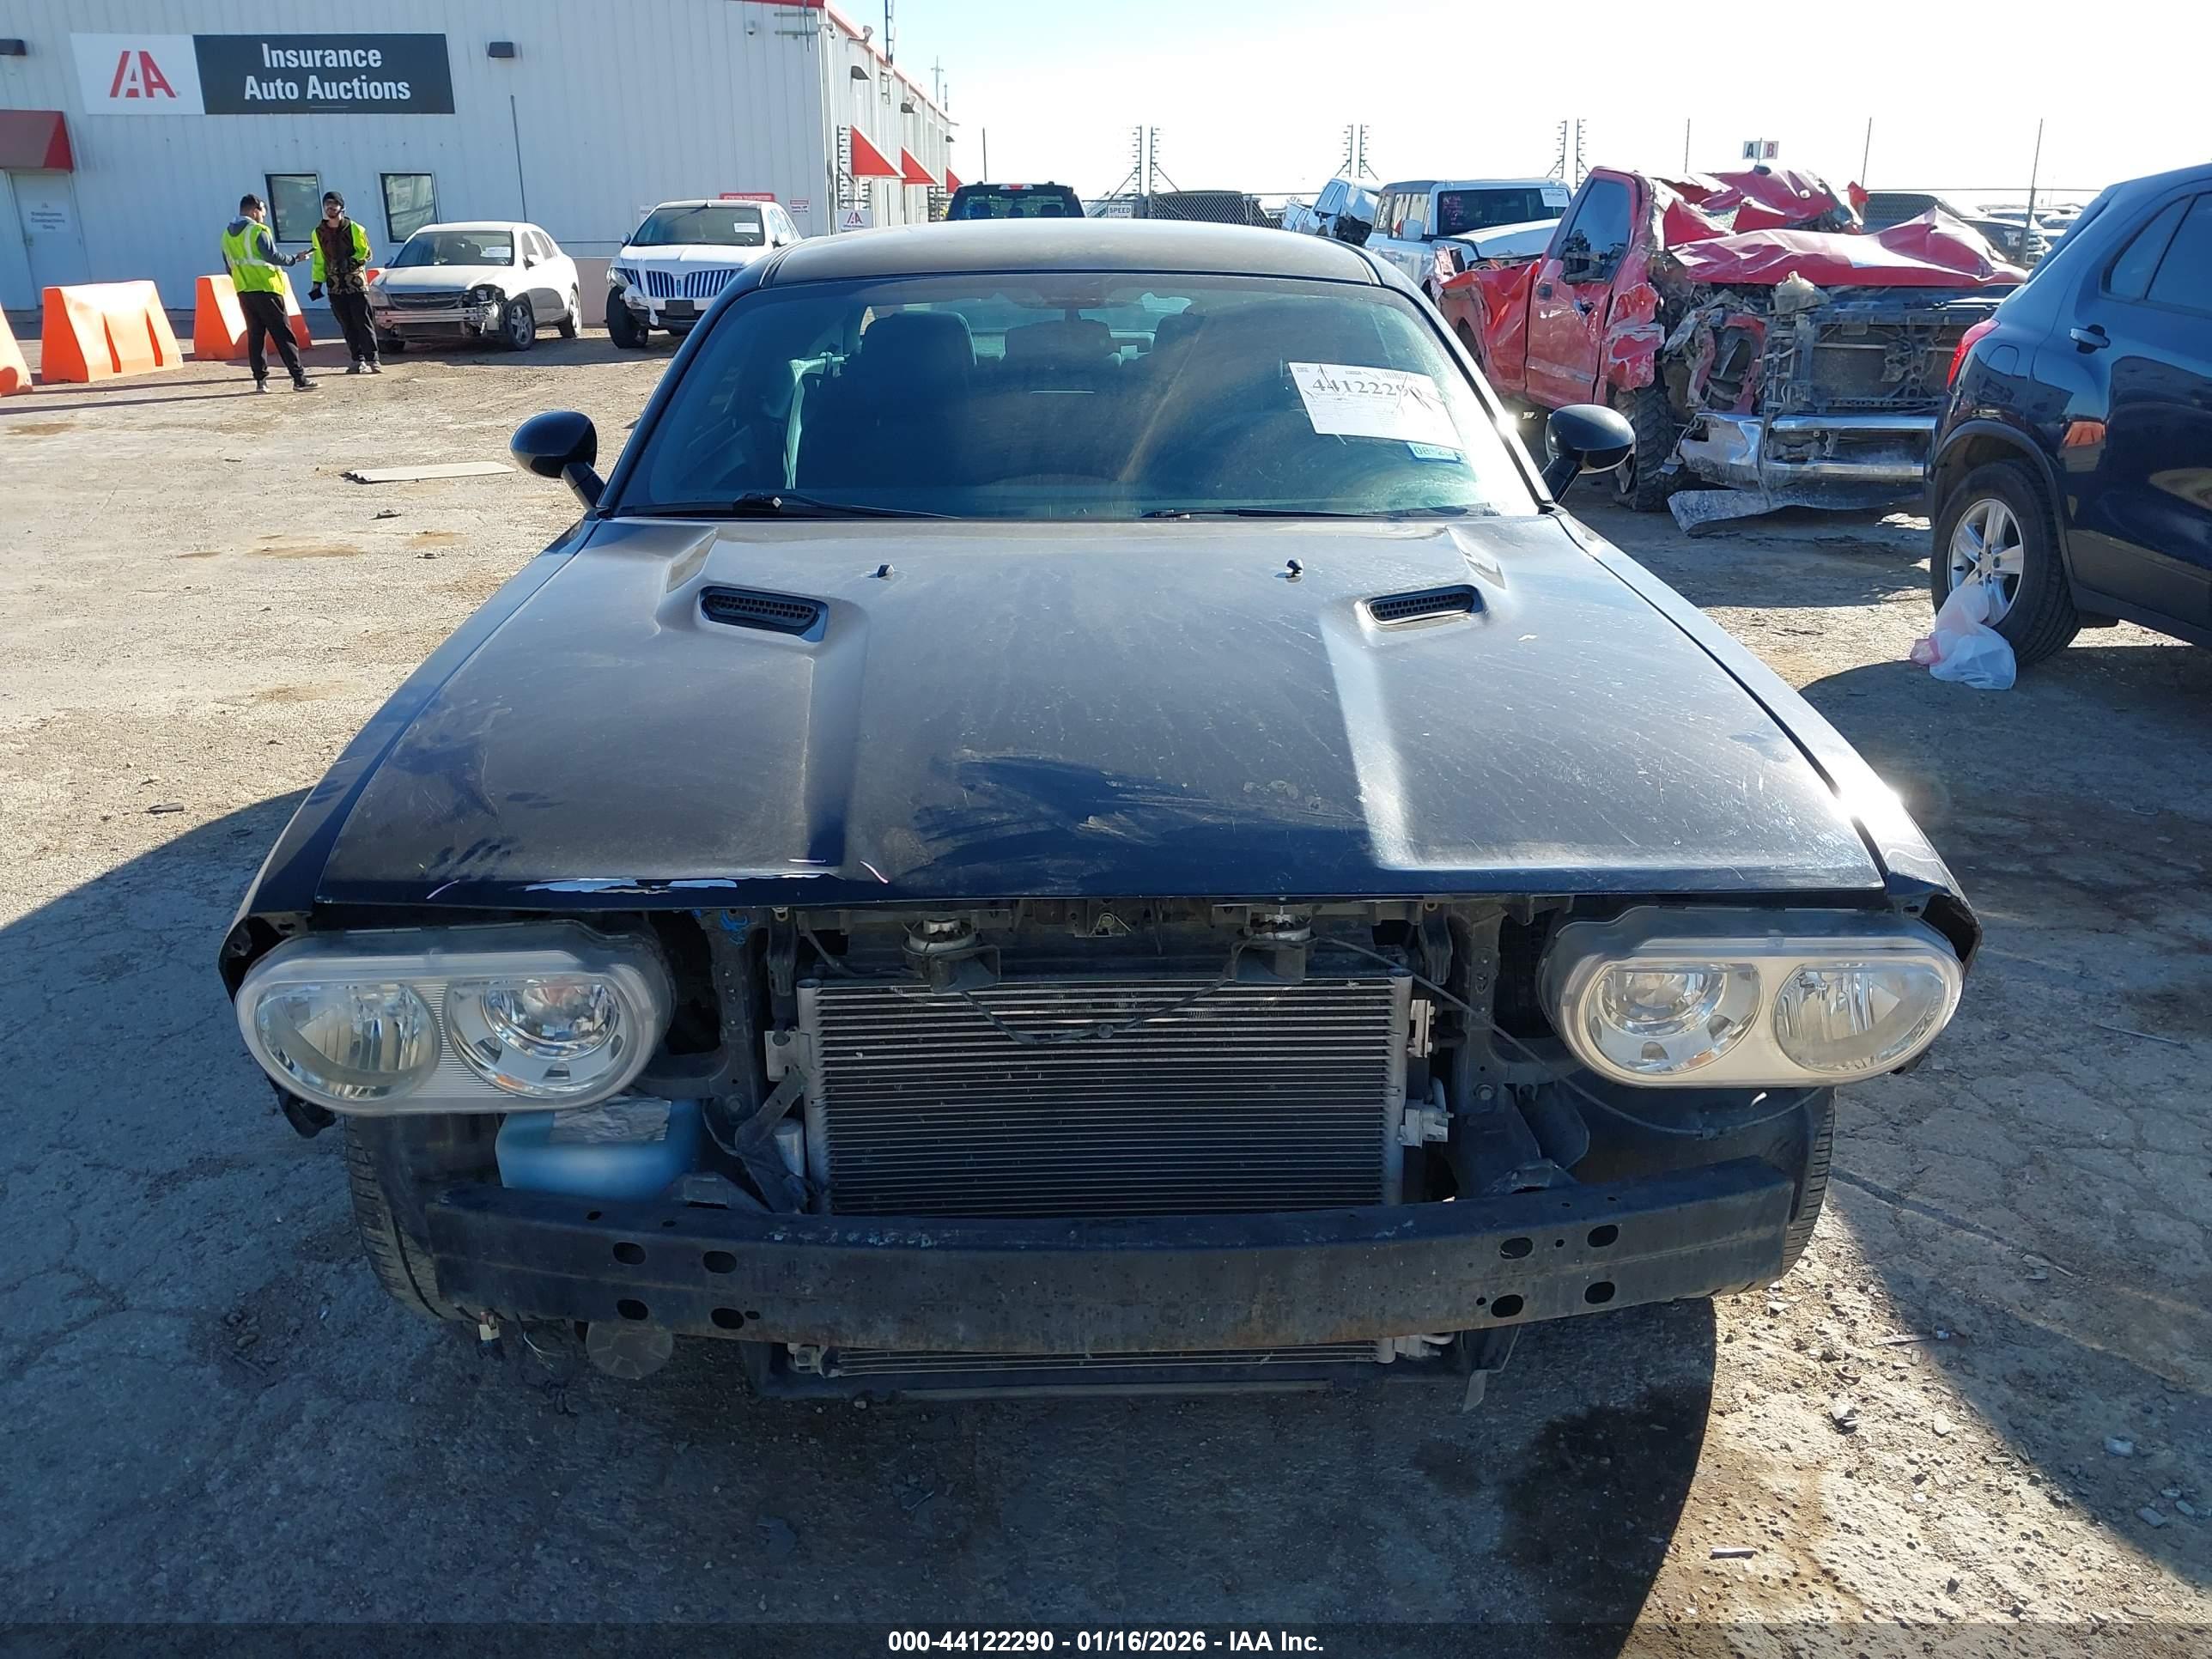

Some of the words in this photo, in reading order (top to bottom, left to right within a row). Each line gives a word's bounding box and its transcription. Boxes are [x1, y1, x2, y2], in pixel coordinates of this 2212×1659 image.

[261, 43, 382, 68] Insurance
[244, 76, 299, 100] Auto
[307, 75, 411, 100] Auctions
[1746, 143, 1754, 158] A
[1765, 143, 1775, 158] B
